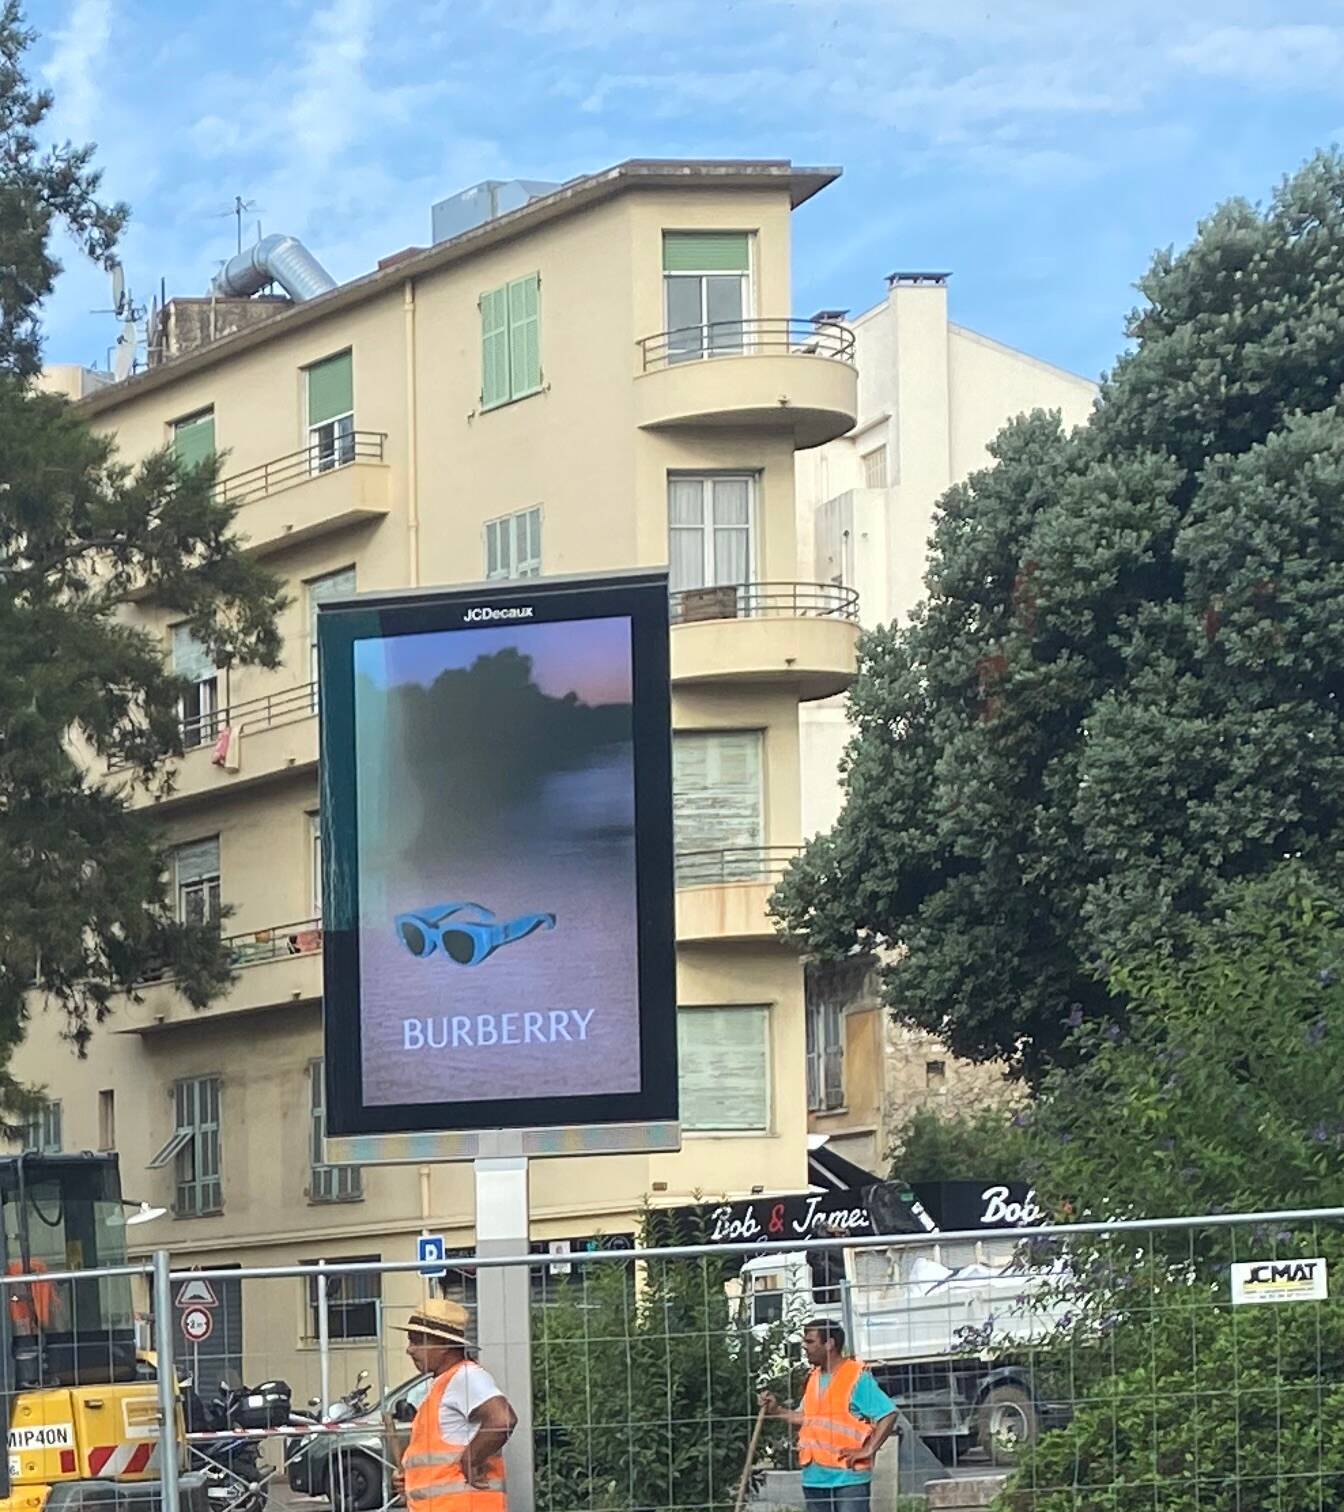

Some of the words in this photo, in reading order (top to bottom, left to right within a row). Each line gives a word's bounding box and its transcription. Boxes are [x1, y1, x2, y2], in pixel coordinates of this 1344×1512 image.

[463, 607, 534, 622] JCDecaux
[402, 1008, 596, 1050] BURBERRY
[711, 1205, 761, 1240] Bob
[769, 1203, 785, 1233] &
[980, 1186, 1047, 1223] Bob
[1243, 1262, 1318, 1284] JCMAT
